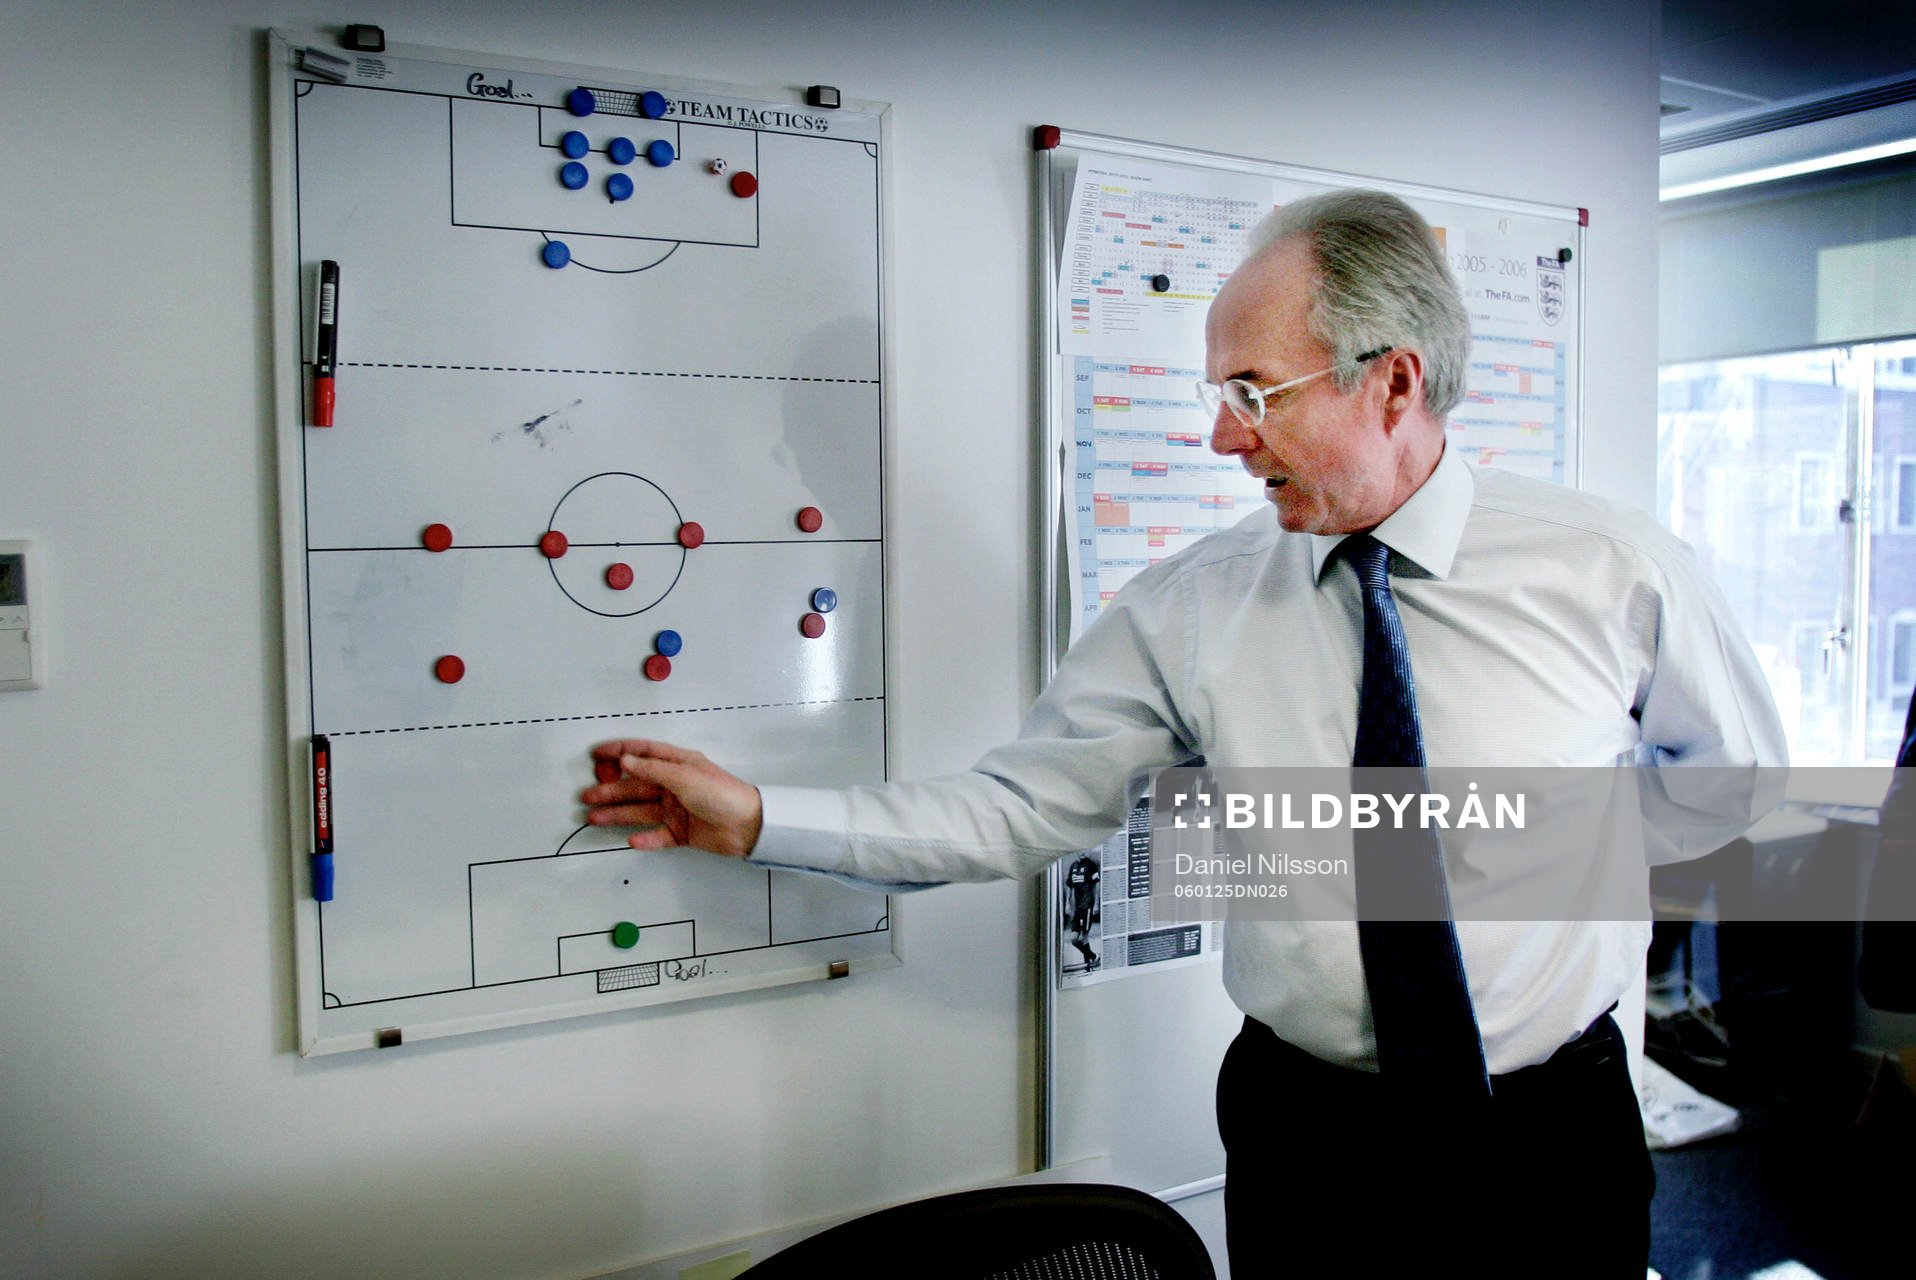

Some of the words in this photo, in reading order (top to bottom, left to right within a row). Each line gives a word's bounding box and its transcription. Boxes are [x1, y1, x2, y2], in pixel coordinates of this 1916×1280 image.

[677, 100, 733, 121] TEAM
[736, 107, 814, 130] TACTICS
[1457, 255, 1486, 273] 2005
[1498, 258, 1528, 277] 2006
[1485, 289, 1530, 303] TheFA.com
[1076, 407, 1091, 415] OCT
[1076, 440, 1092, 448] NOV
[1077, 472, 1092, 480] DEC
[317, 767, 327, 786] 40
[317, 787, 328, 829] edding
